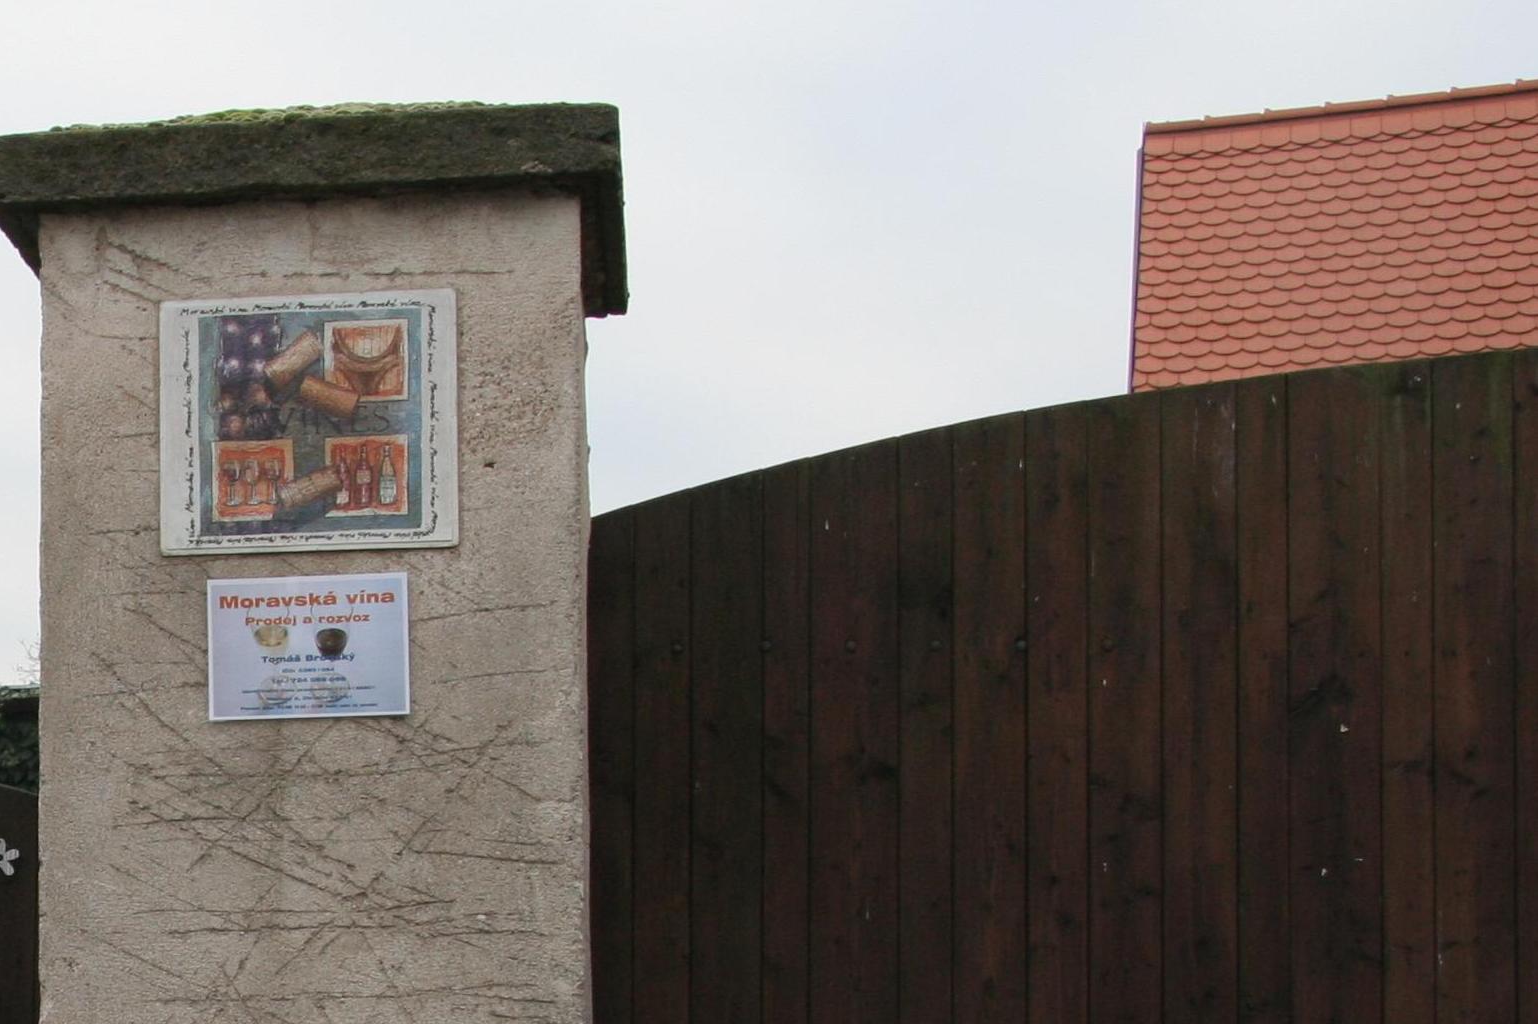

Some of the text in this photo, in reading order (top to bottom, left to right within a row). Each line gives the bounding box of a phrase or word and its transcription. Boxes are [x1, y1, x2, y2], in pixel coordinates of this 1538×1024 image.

[219, 590, 395, 609] Moravská vína
[245, 614, 371, 627] Prodej a rozvoz
